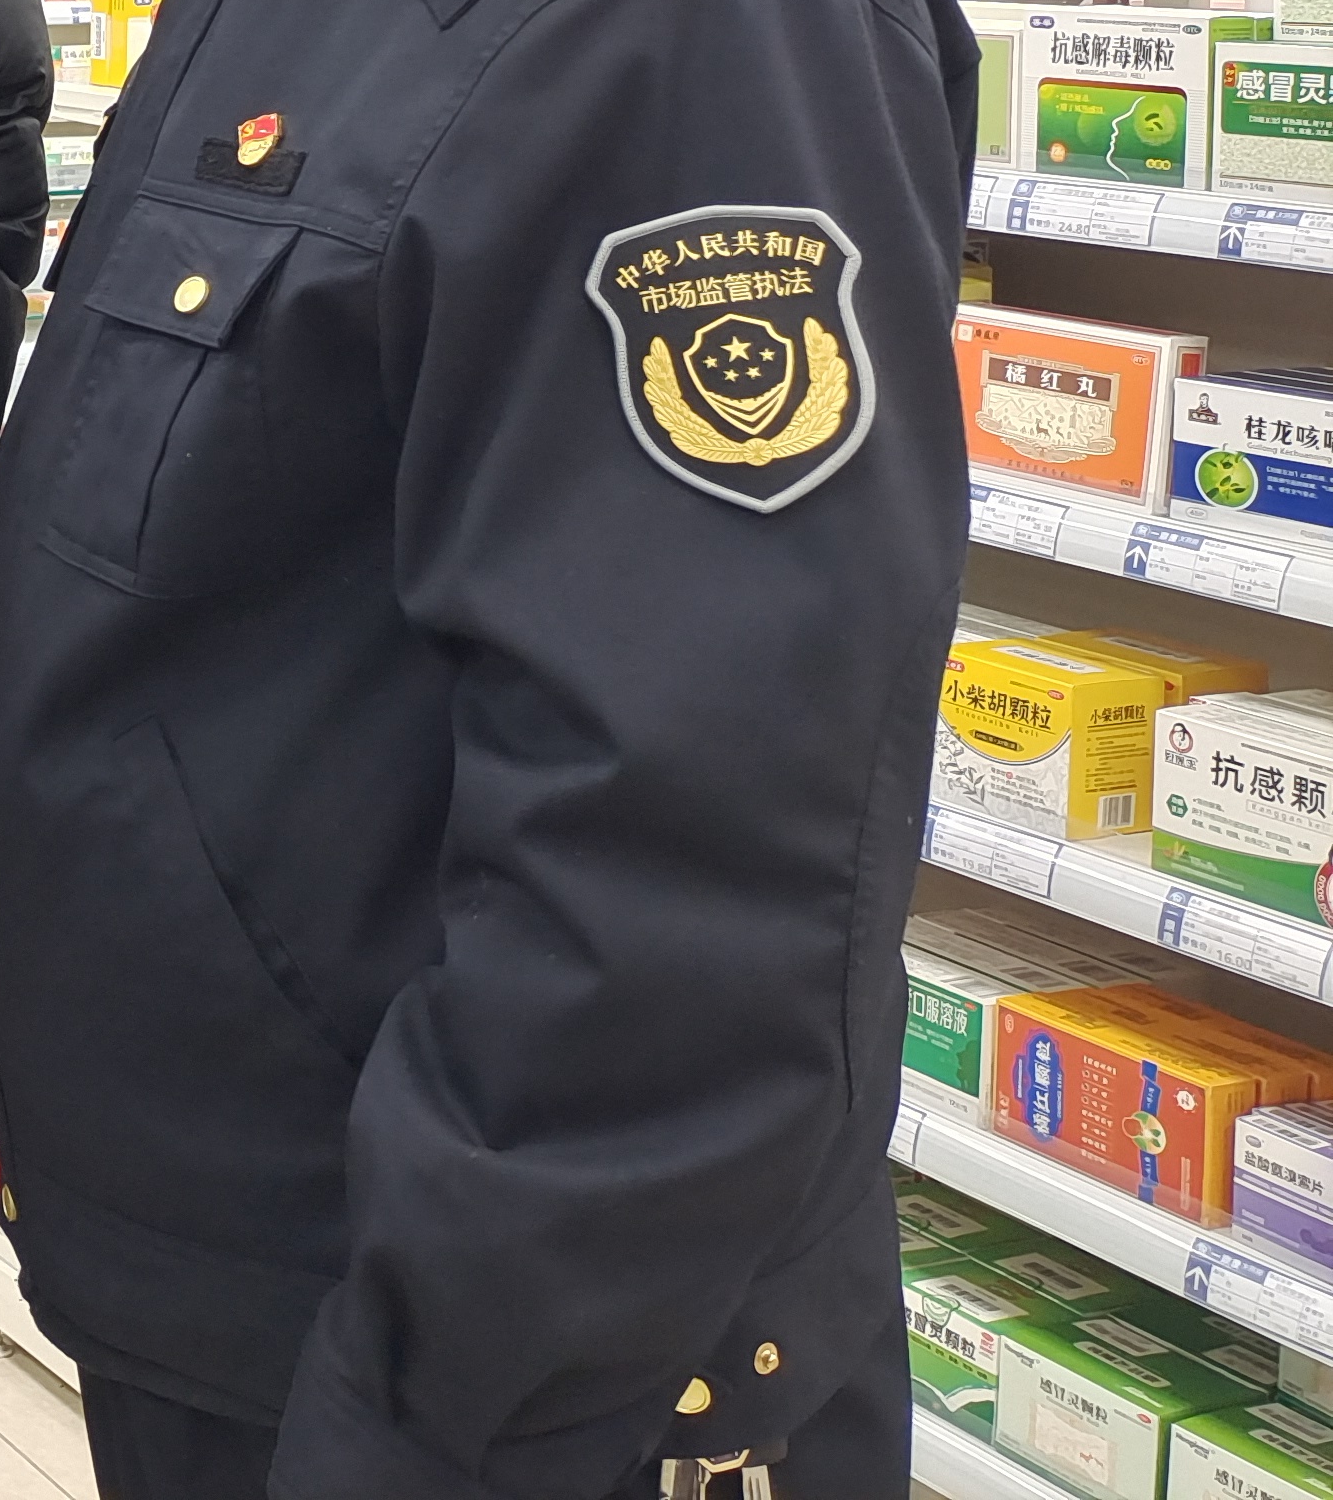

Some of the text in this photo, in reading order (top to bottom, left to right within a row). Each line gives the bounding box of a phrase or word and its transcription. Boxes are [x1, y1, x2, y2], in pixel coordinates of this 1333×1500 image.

[1050, 31, 1176, 72] 抗感解毒颗粒
[1235, 70, 1333, 106] 感冒灵
[614, 229, 827, 291] 中华人民共和国
[638, 266, 814, 314] 市场监管执法
[1004, 361, 1097, 398] 橘红丸
[944, 679, 1052, 731] 小柴胡颗粒
[1089, 704, 1146, 724] 小柴胡颗粒
[909, 991, 969, 1037] 口服溶液
